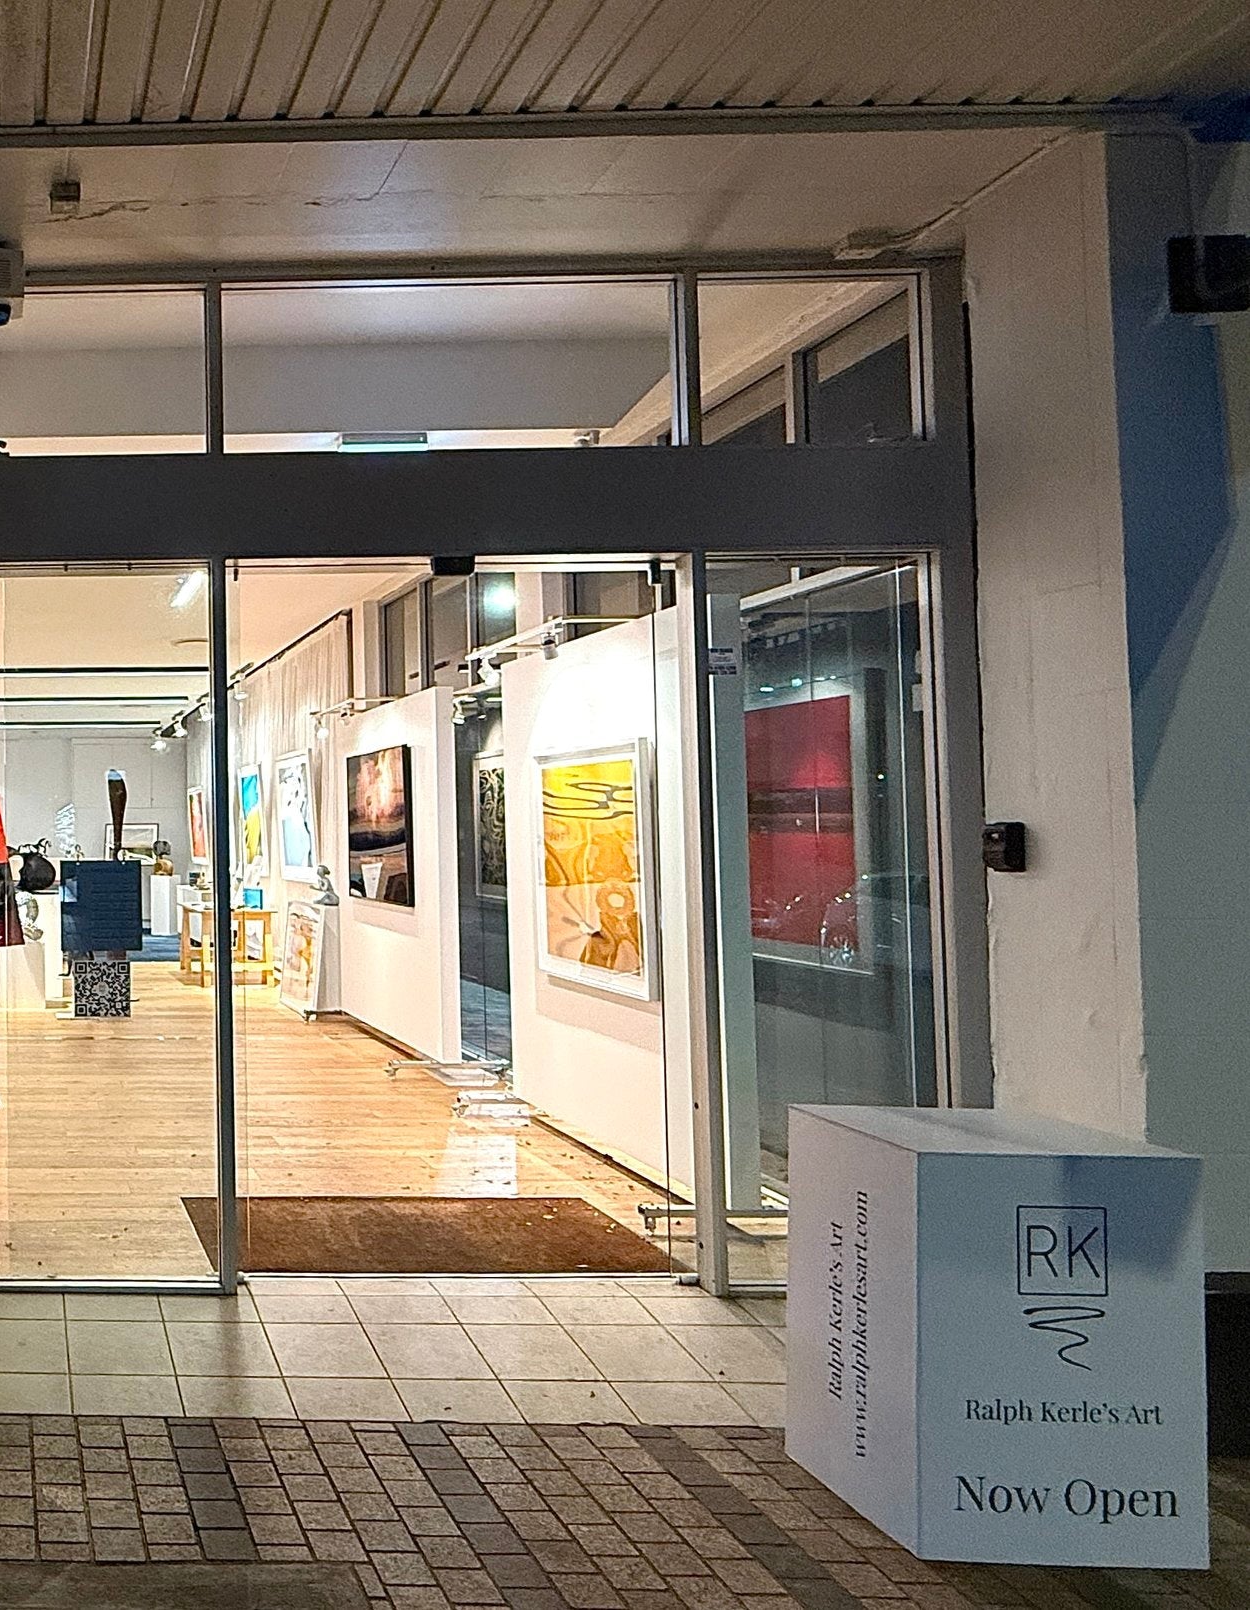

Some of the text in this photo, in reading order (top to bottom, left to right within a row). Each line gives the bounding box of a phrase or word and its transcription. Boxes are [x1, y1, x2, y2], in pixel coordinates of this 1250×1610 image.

[830, 1221, 843, 1258] Art
[1026, 1224, 1100, 1278] RK
[851, 1190, 869, 1457] www.ralphkerlesart.com
[827, 1337, 844, 1400] Ralph
[965, 1399, 1164, 1426] Ralph Kerle's Art
[953, 1475, 1181, 1525] Now Open
